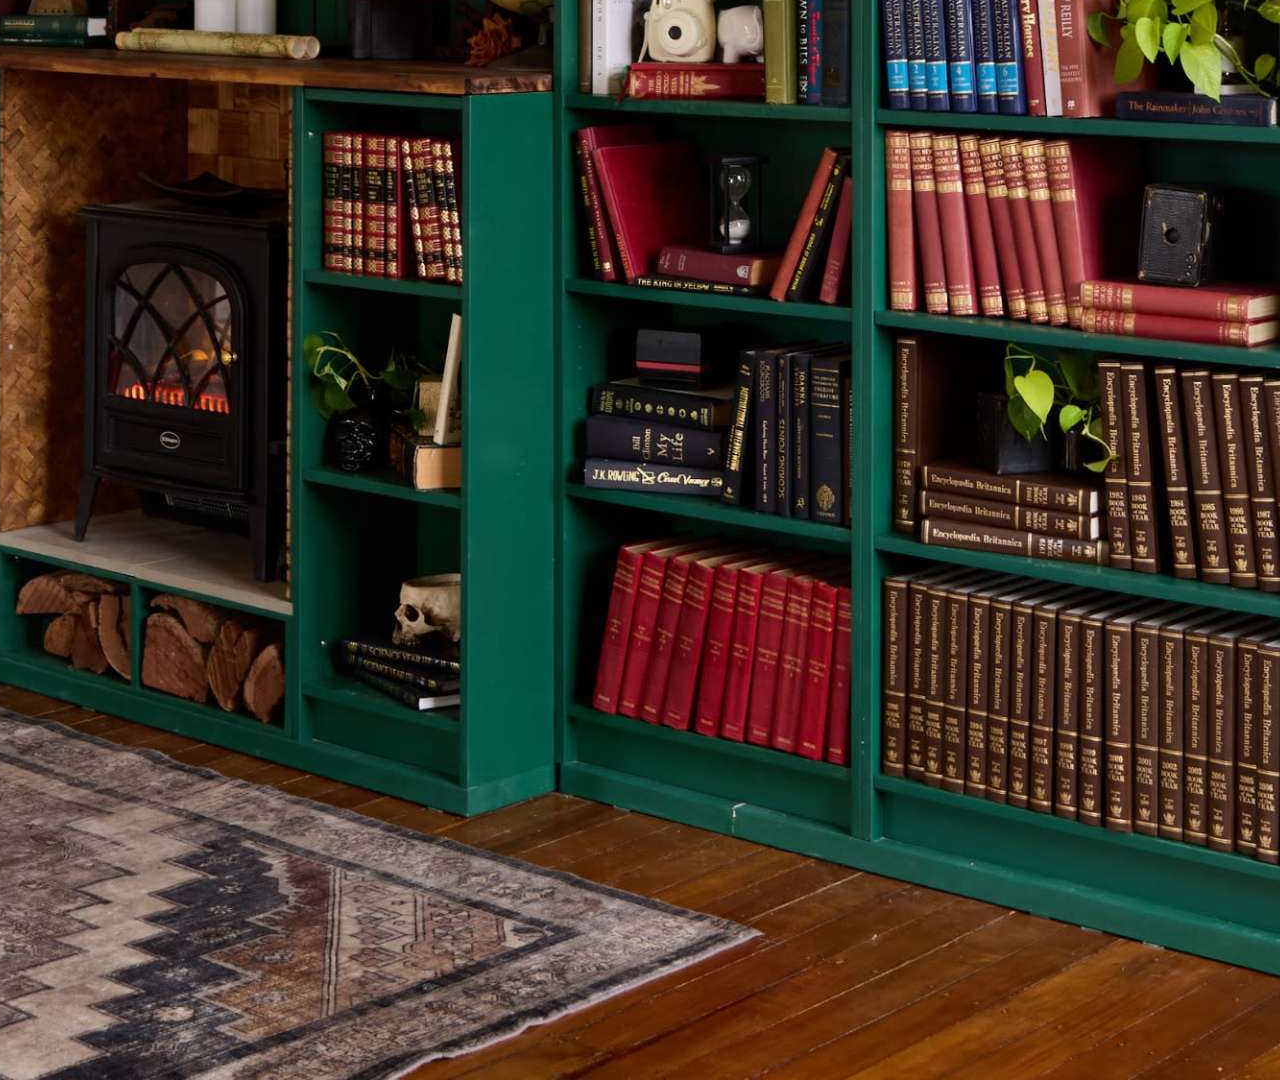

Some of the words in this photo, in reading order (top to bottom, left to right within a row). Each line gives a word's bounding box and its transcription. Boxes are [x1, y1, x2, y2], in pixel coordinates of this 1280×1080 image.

[1060, 3, 1072, 38] REILLY
[1023, 15, 1035, 58] Houses
[799, 37, 807, 65] BITS
[653, 279, 673, 288] KING
[632, 436, 641, 451] Bill
[643, 428, 652, 460] Clinton
[657, 432, 671, 457] My
[673, 432, 684, 463] Life
[1169, 436, 1178, 481] Britannica
[1199, 439, 1209, 485] Britannica
[607, 469, 639, 482] ROWLING
[983, 535, 1023, 549] Britannica
[369, 647, 398, 661] SCIENCE
